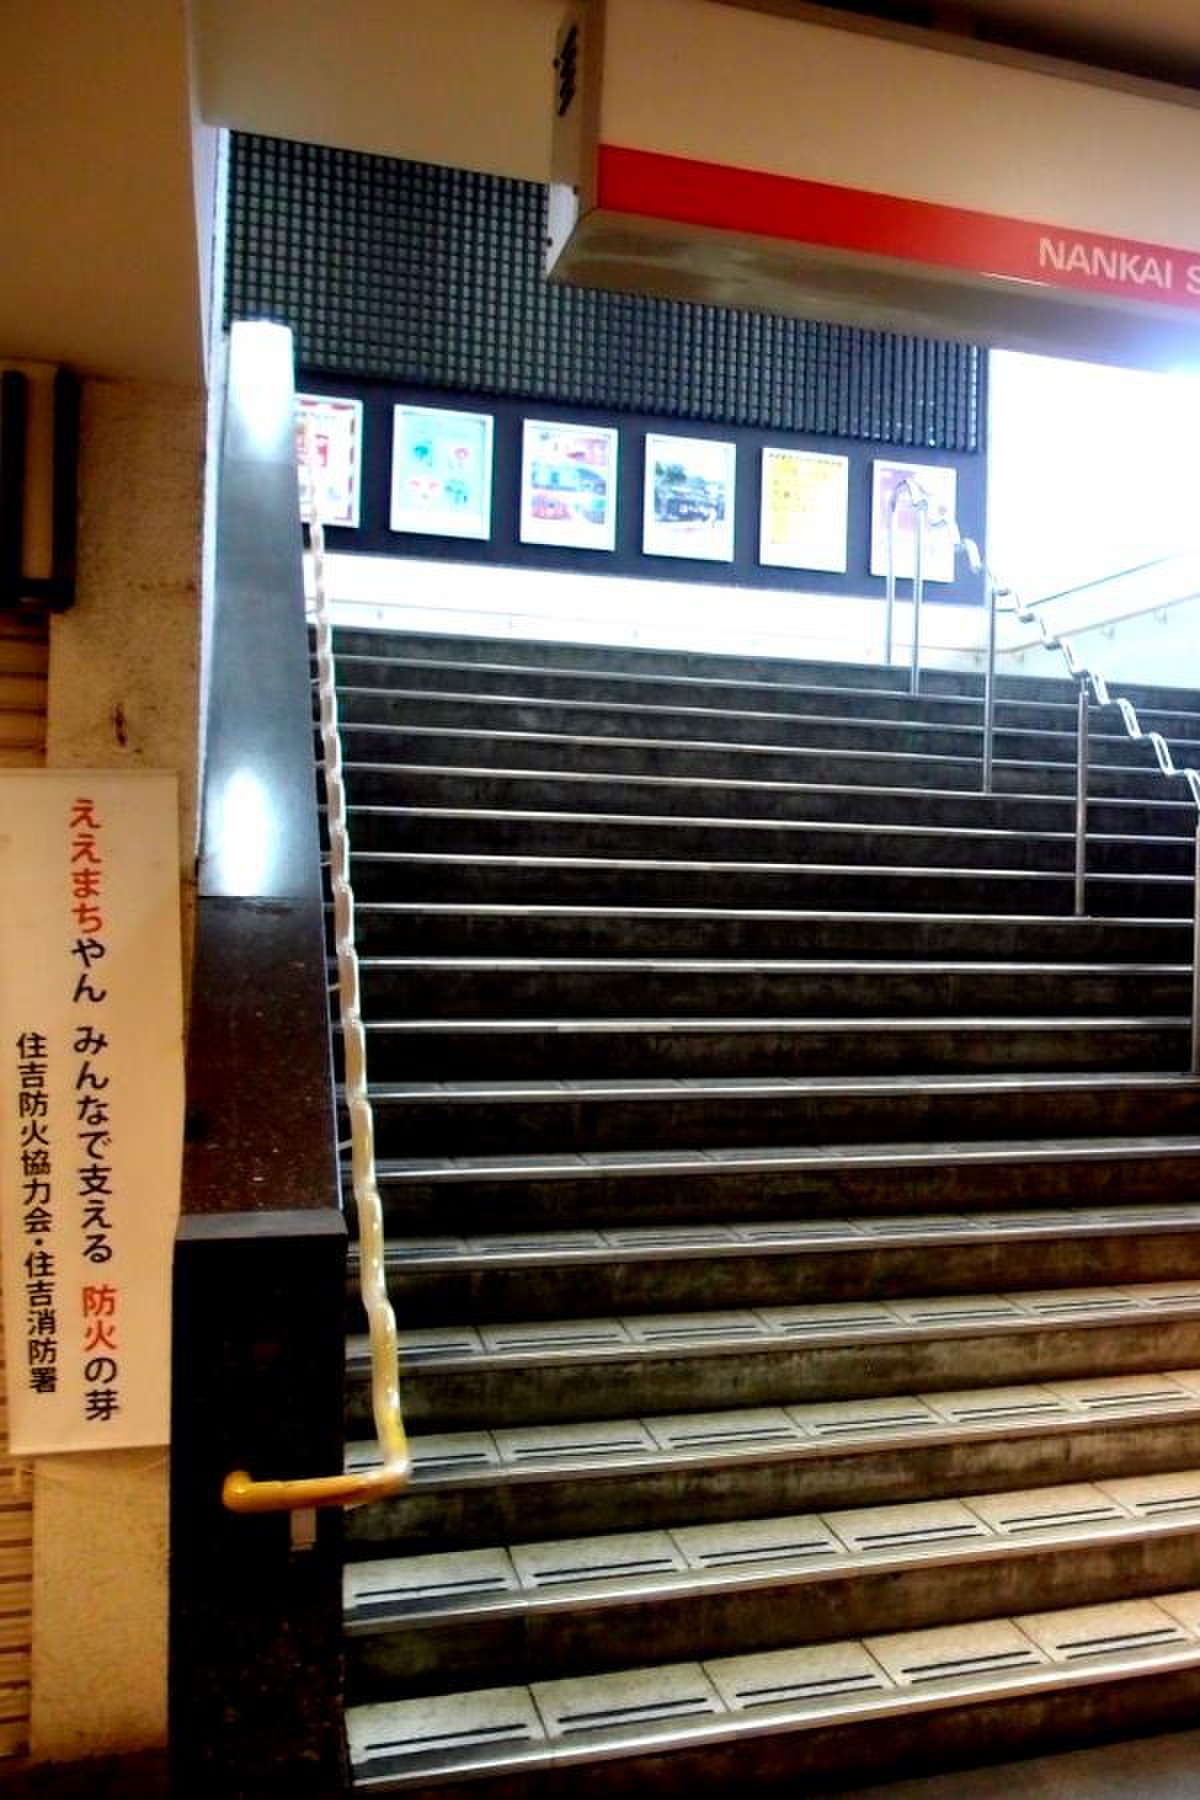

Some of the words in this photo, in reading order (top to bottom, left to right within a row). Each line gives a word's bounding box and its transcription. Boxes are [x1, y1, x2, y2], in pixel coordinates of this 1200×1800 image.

[1039, 237, 1173, 289] NANKAI
[69, 798, 108, 1004] ええまちやん
[16, 1030, 57, 1394] 住吉防火協力会・住吉消防署
[73, 1025, 114, 1264] みんなで支える
[81, 1283, 120, 1422] 防火の芽
